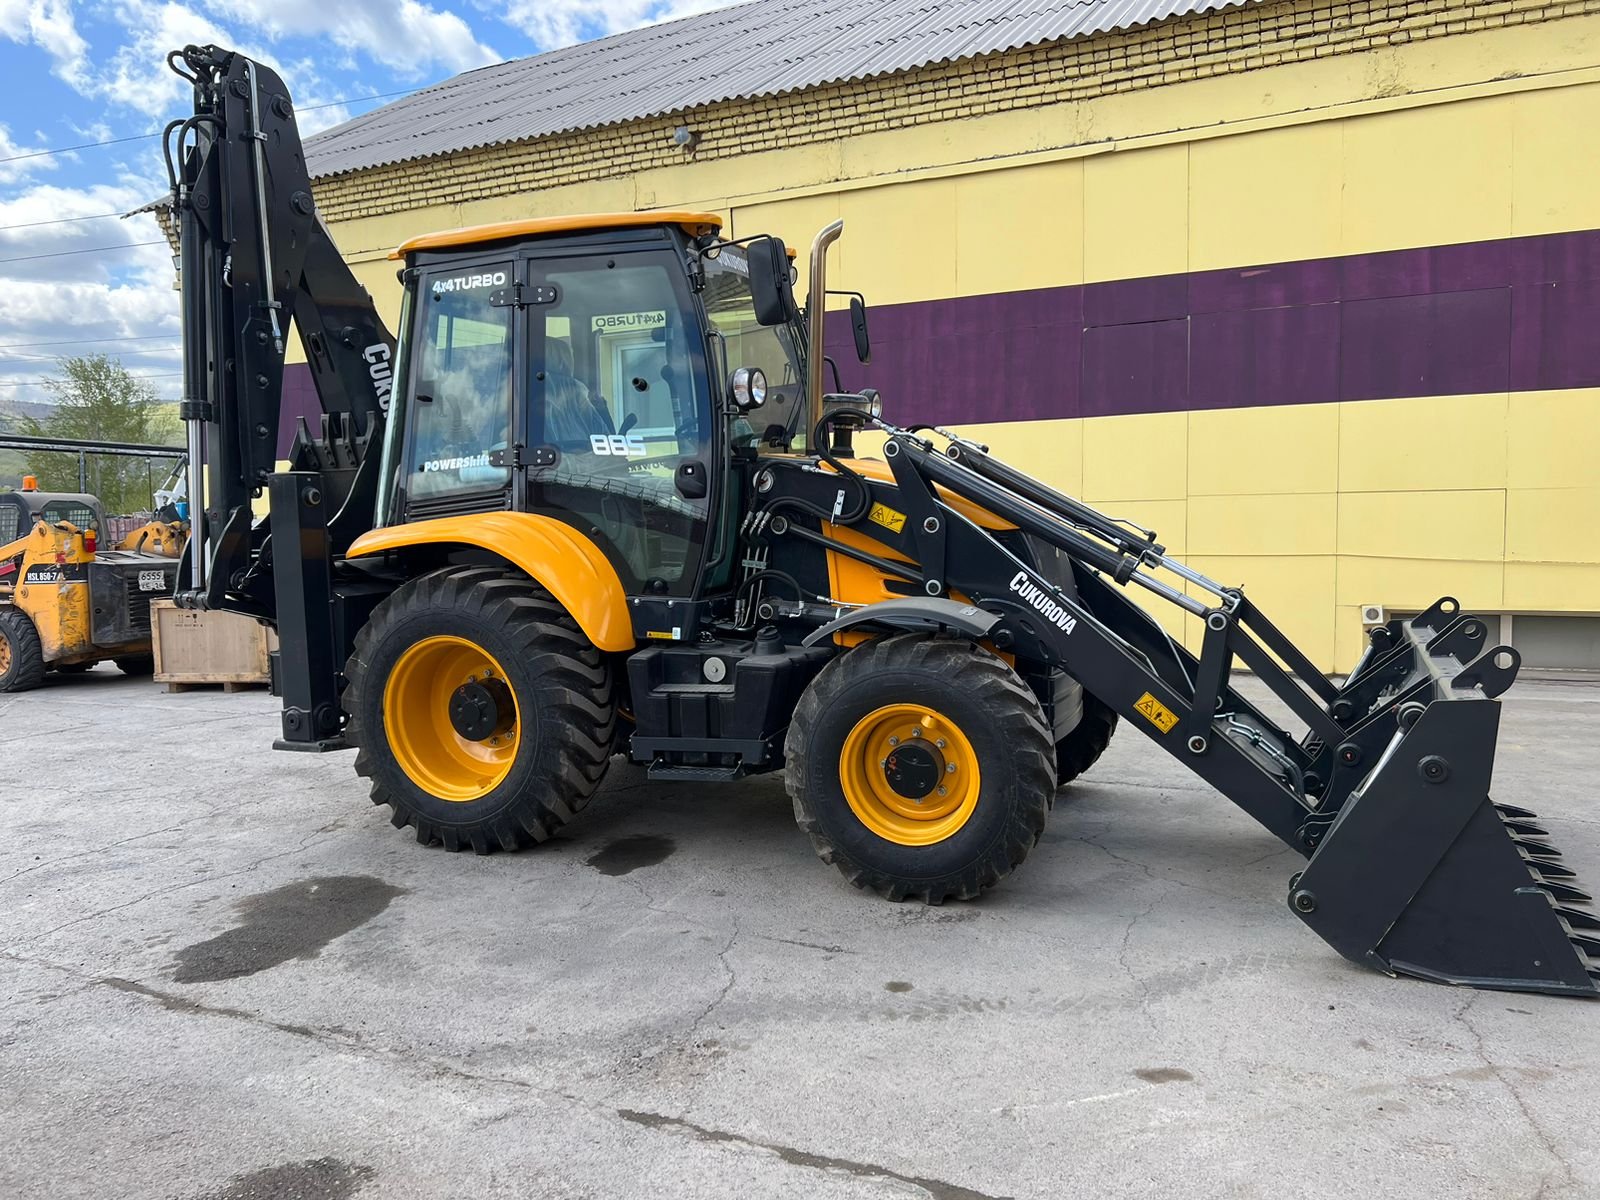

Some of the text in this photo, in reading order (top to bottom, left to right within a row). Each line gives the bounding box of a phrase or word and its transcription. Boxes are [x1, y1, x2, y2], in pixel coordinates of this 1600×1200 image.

[432, 272, 506, 293] 4x4TURBO
[141, 571, 161, 581] 6555
[1009, 571, 1077, 635] ÇUKUROVA
